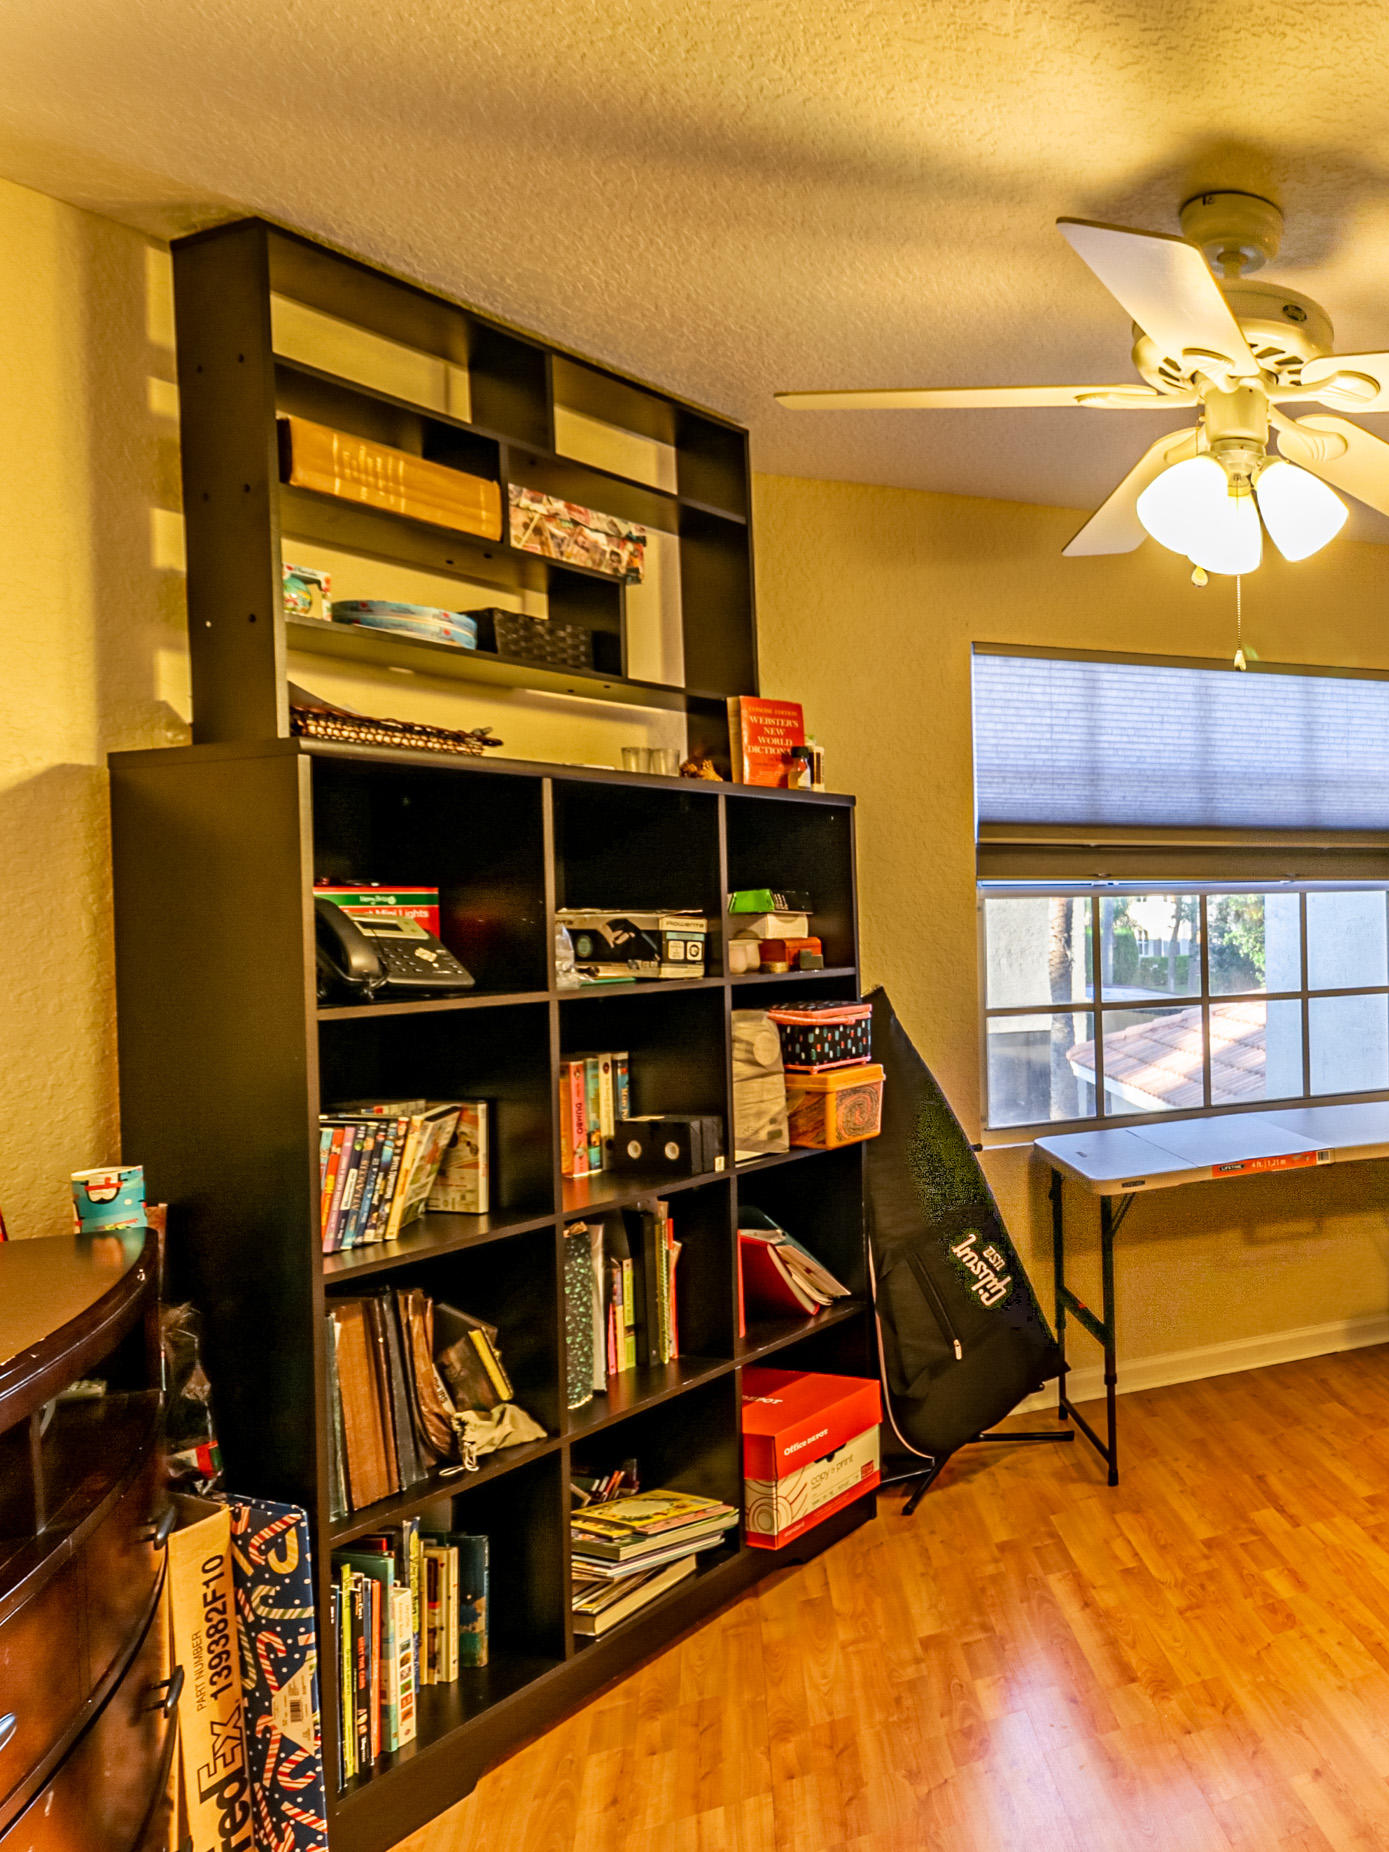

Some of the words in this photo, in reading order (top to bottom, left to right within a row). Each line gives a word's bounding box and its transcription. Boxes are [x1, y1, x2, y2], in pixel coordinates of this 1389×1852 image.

[757, 736, 793, 746] WORLD
[763, 726, 786, 736] NEW
[951, 1233, 1012, 1306] Gibson
[783, 1440, 807, 1456] Office
[807, 1428, 829, 1446] DEPOT
[201, 1553, 234, 1701] 139382F10
[191, 1630, 206, 1681] NUMBER
[196, 1684, 207, 1712] PART
